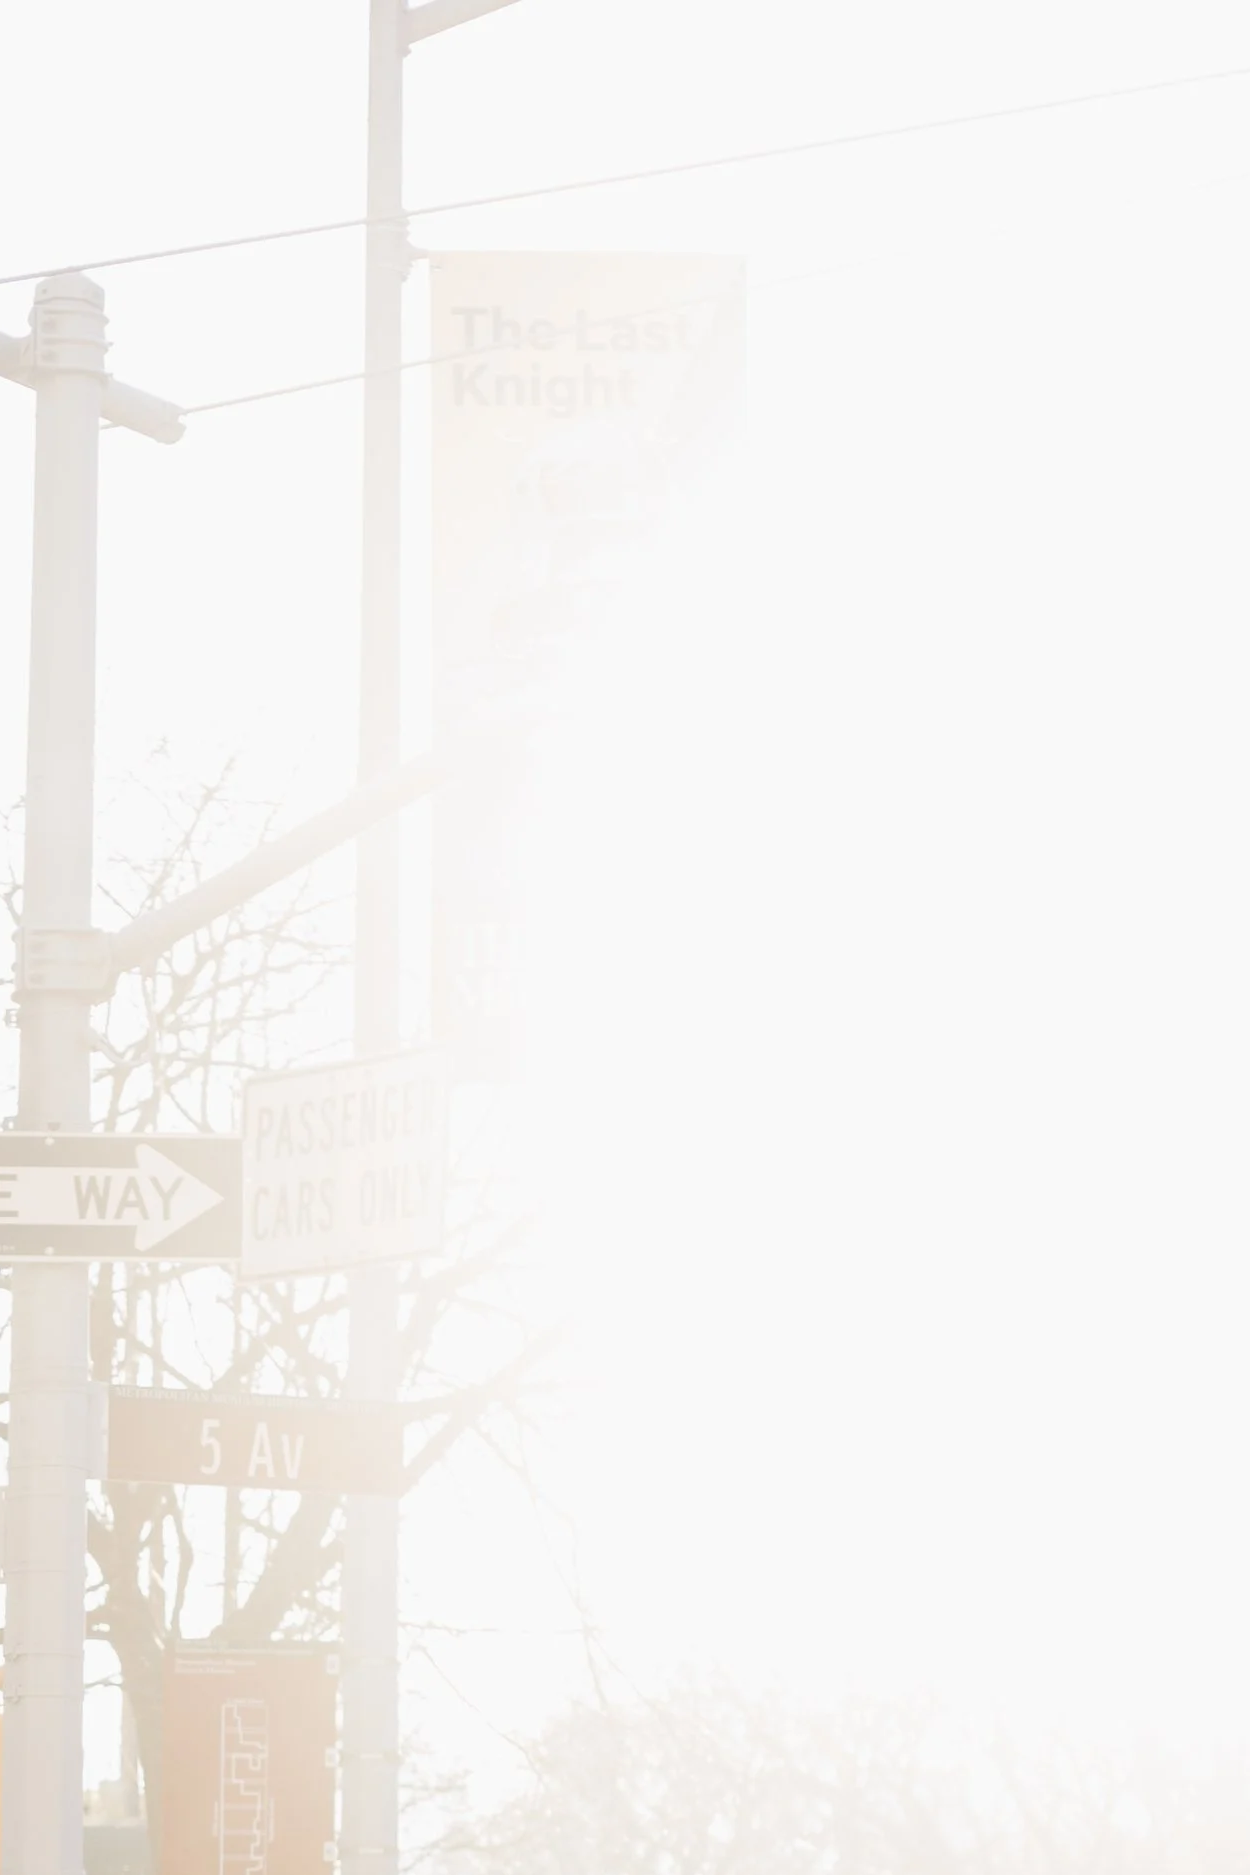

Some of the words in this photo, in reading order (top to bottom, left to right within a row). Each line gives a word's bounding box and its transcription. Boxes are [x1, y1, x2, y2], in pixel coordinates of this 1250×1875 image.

[450, 304, 558, 351] The
[575, 307, 693, 354] Last
[450, 361, 639, 419] Knight
[256, 1075, 437, 1163] PASSENGER
[72, 1174, 185, 1222] WAY
[253, 1176, 337, 1241] CARS
[360, 1160, 432, 1228] ONLY
[199, 1418, 222, 1476] 5
[247, 1421, 305, 1480] Av
